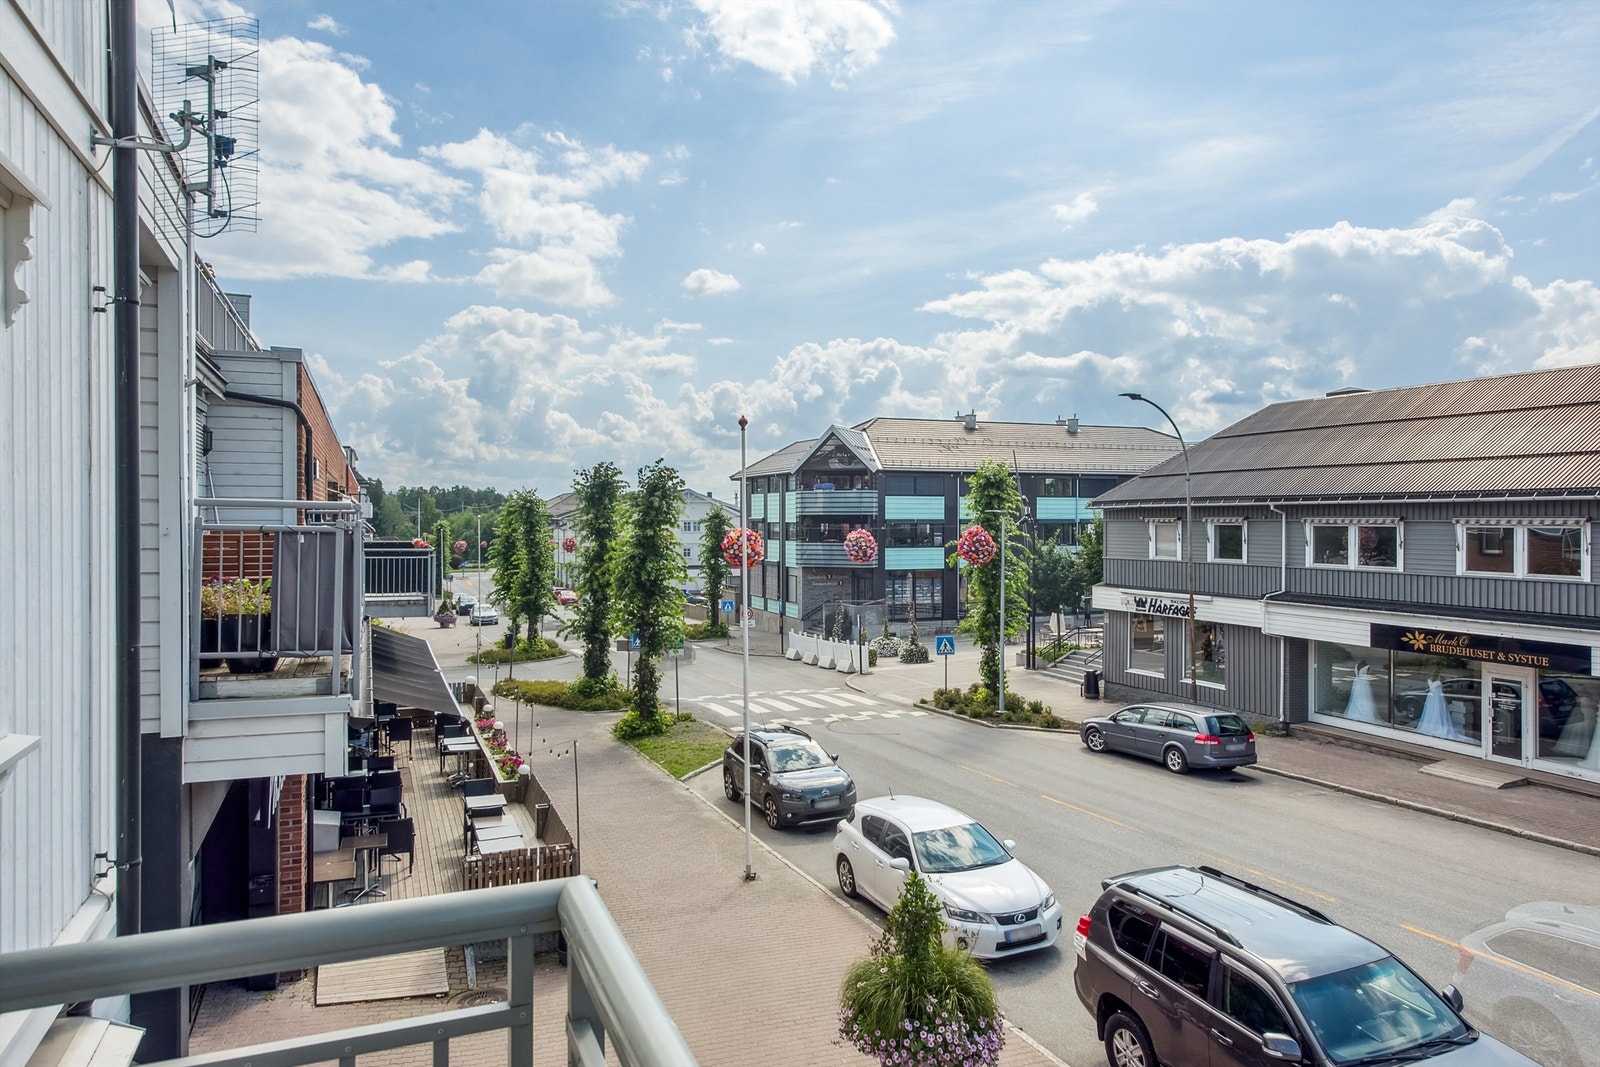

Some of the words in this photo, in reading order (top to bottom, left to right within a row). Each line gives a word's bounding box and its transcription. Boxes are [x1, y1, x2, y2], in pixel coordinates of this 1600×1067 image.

[1430, 644, 1496, 660] BRUDEHUSET
[1497, 652, 1506, 661] &
[1508, 653, 1549, 667] SYSTUE
